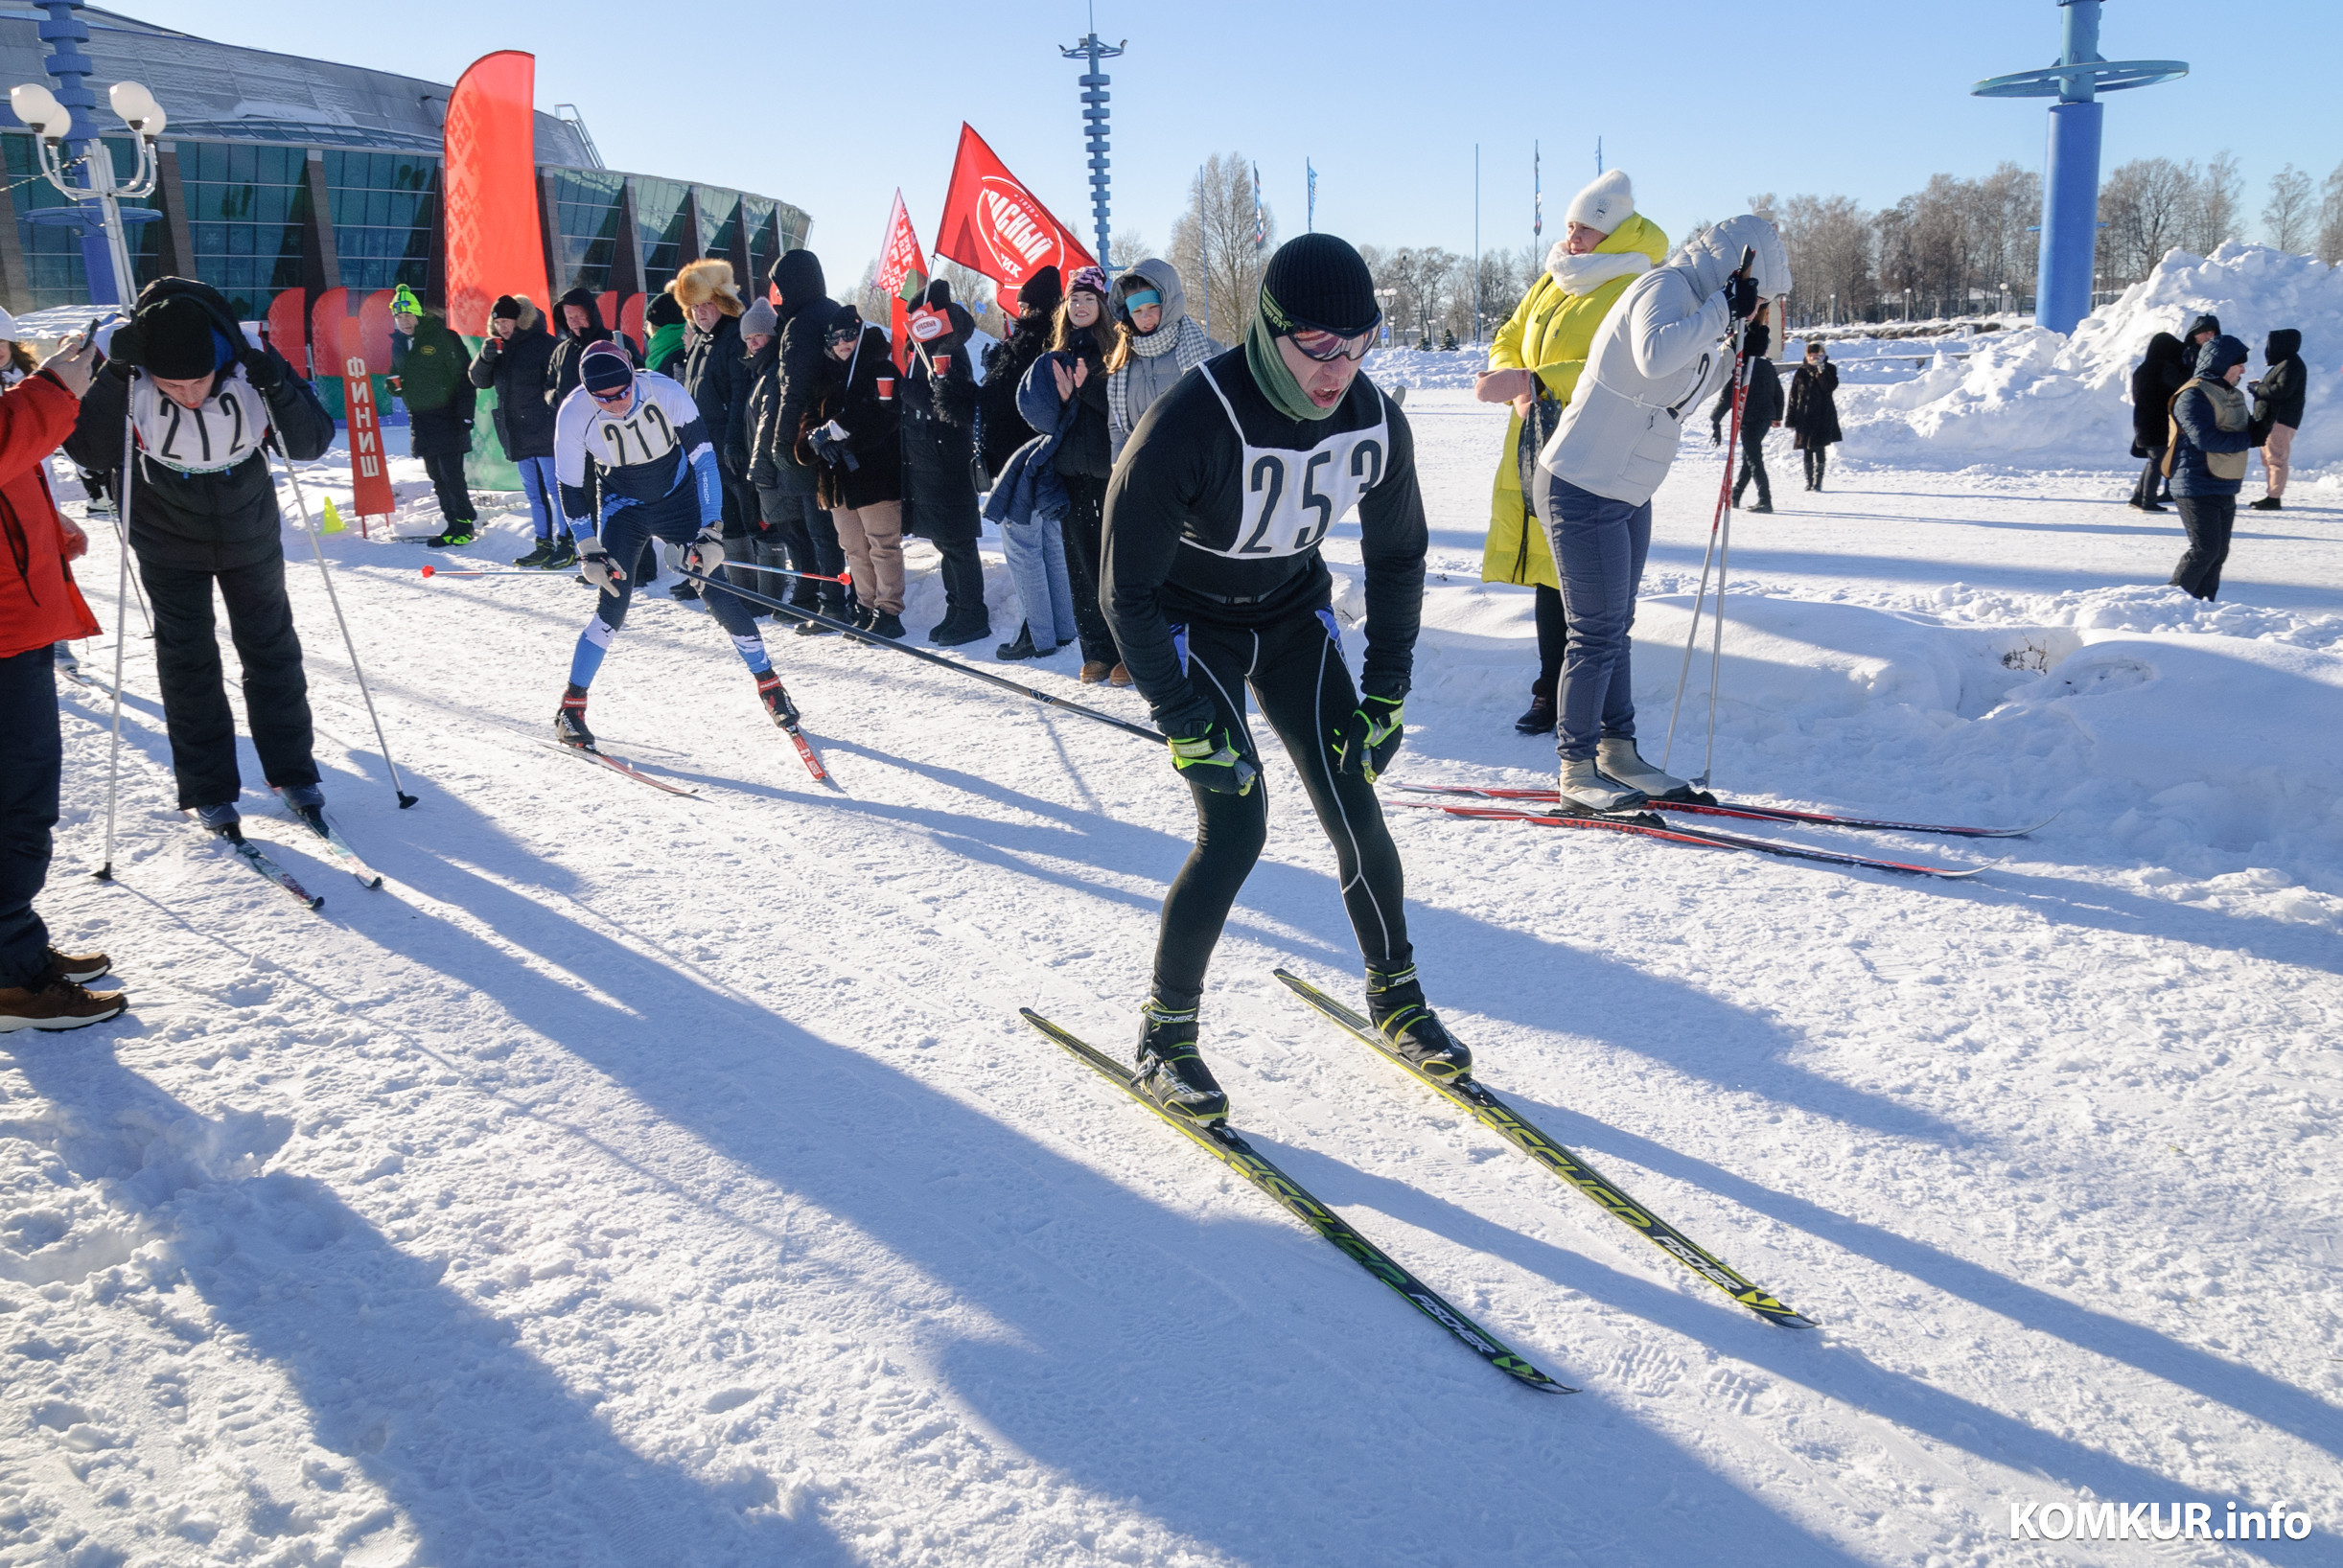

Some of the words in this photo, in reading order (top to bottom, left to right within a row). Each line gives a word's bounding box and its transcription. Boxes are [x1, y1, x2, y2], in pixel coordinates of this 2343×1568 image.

[986, 189, 1054, 265] РАСНЫЙ
[346, 357, 379, 477] ФИНИШ
[1394, 972, 1417, 985] FISC
[1148, 1011, 1194, 1023] FISCHER
[1653, 1235, 1742, 1291] FISCHER
[1409, 1294, 1496, 1353] FISCHER
